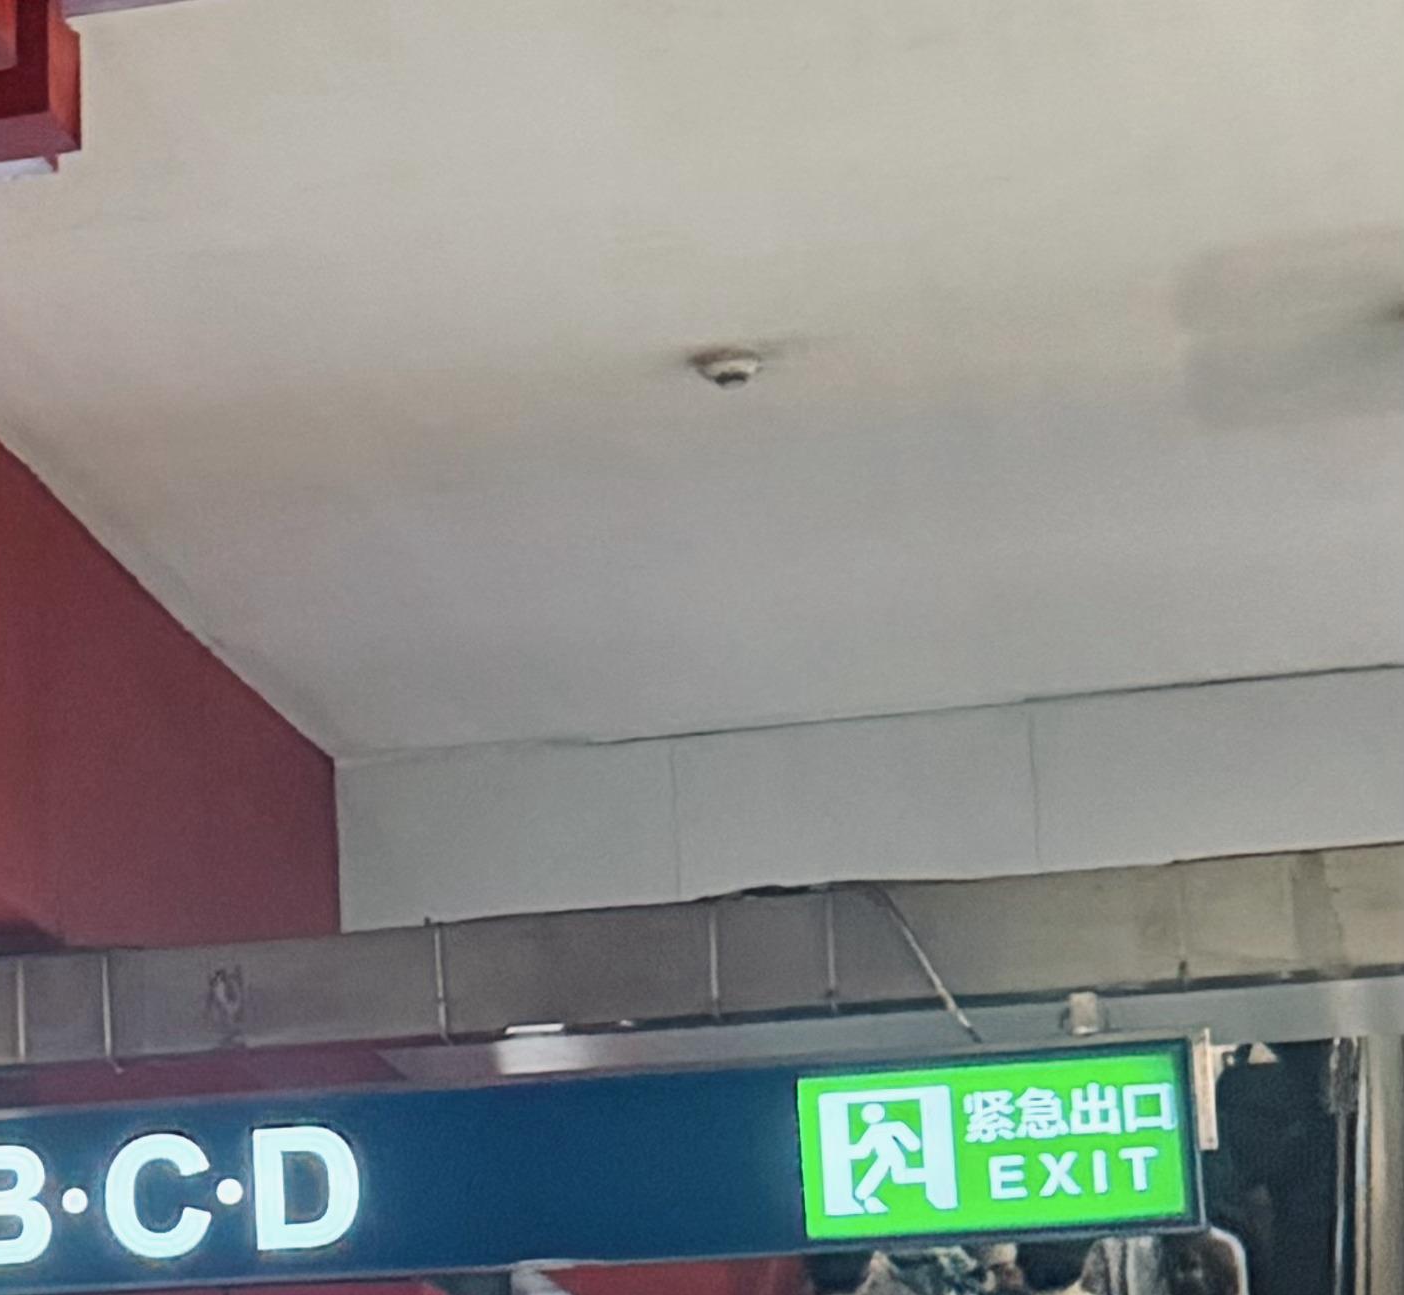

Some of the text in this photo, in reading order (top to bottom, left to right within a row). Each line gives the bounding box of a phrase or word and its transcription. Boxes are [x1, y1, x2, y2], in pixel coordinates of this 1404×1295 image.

[962, 1081, 1176, 1144] 紧急出口
[988, 1146, 1159, 1200] EXIT
